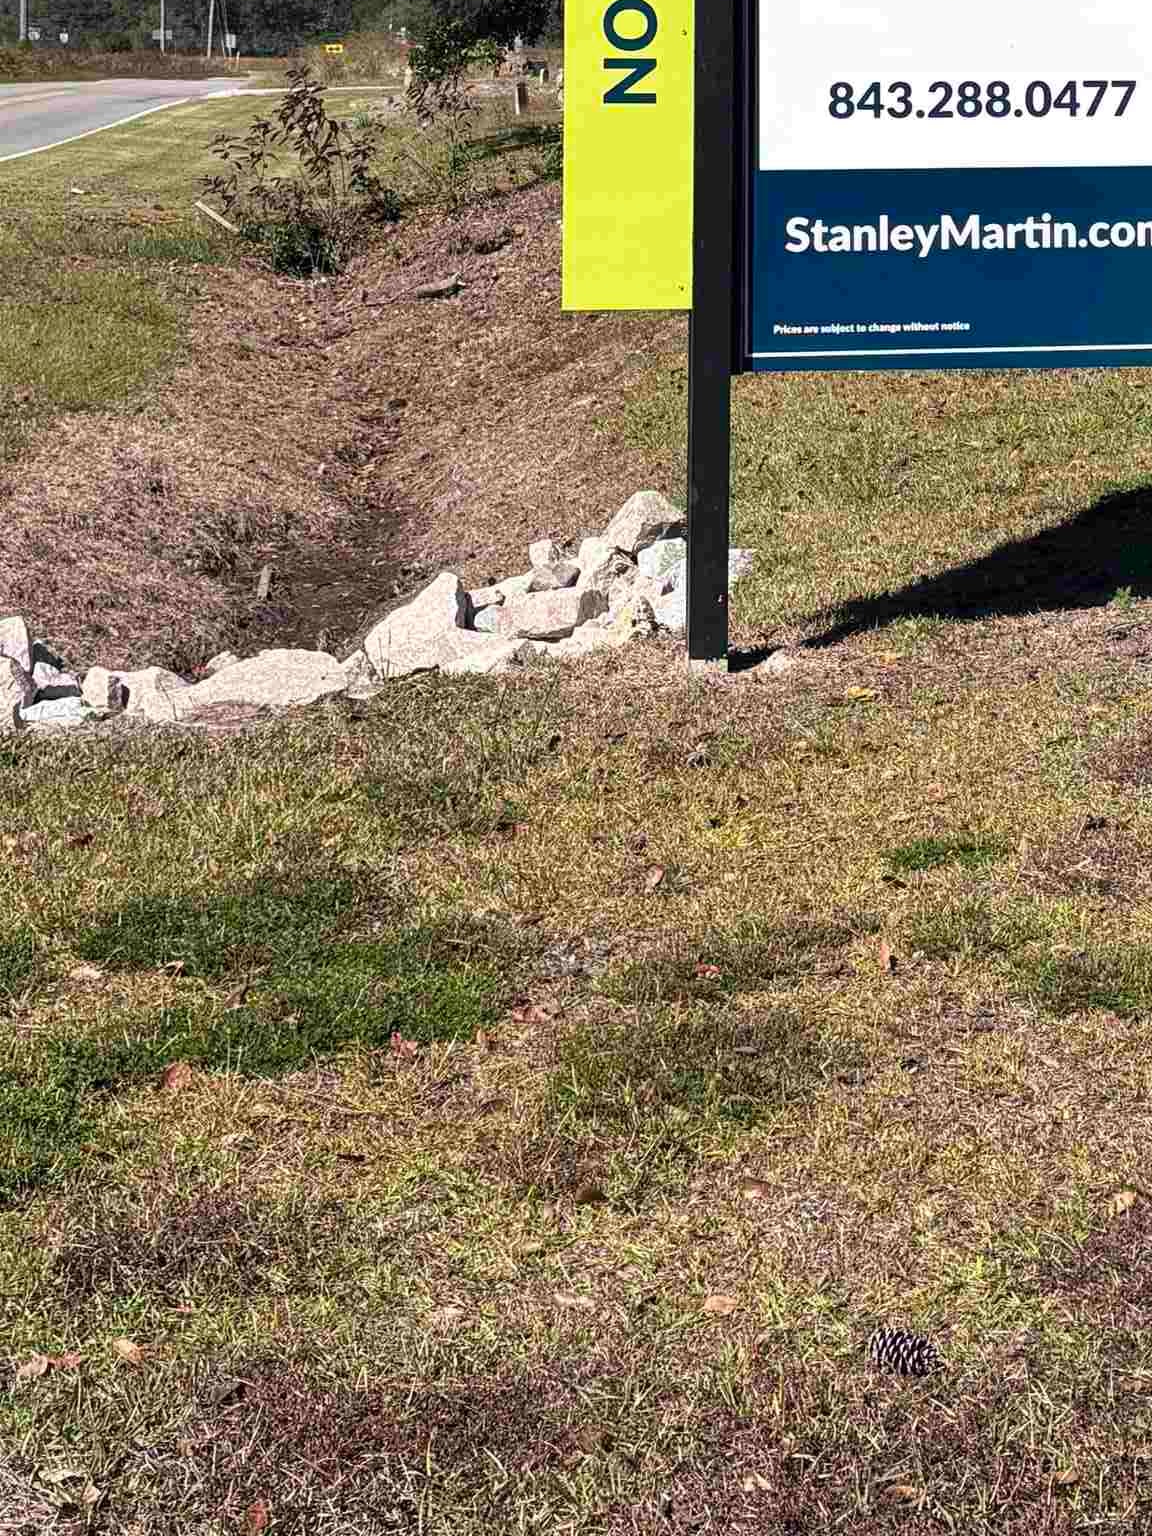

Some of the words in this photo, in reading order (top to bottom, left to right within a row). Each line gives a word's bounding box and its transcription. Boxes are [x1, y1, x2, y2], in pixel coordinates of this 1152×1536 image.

[829, 81, 1136, 119] 843.288.0477
[773, 325, 802, 334] Prices
[803, 325, 819, 333] are
[820, 323, 854, 334] subject
[856, 323, 867, 332] to
[868, 322, 901, 333] change
[902, 322, 940, 331] without
[941, 321, 970, 330] notice
